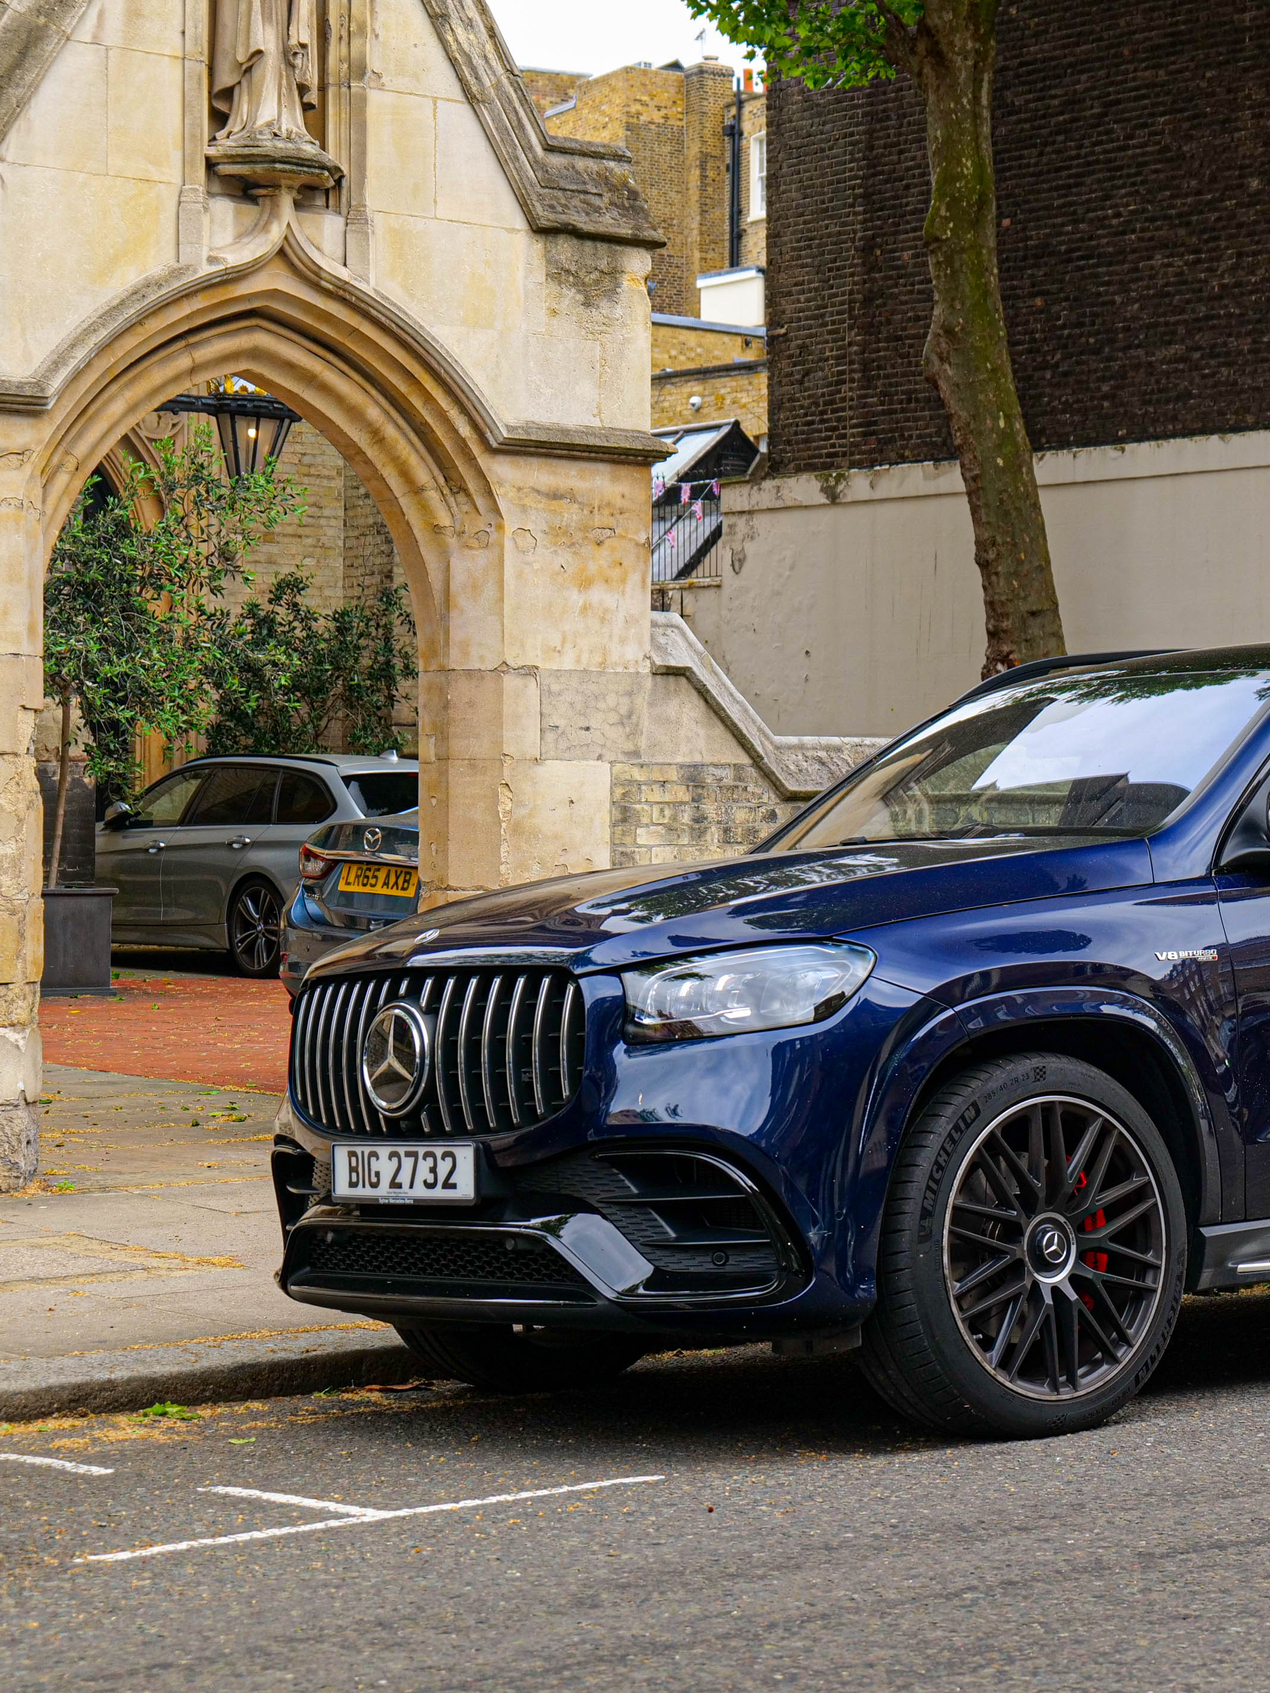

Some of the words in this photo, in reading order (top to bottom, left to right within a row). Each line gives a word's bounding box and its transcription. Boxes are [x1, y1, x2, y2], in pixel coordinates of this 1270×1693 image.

[345, 865, 381, 888] LR65
[381, 868, 413, 891] AXB
[1154, 951, 1178, 961] V8
[1179, 949, 1217, 957] BITURBO
[347, 1150, 381, 1189] BIG
[388, 1150, 457, 1190] 2732
[922, 1103, 979, 1213] MICHELIN
